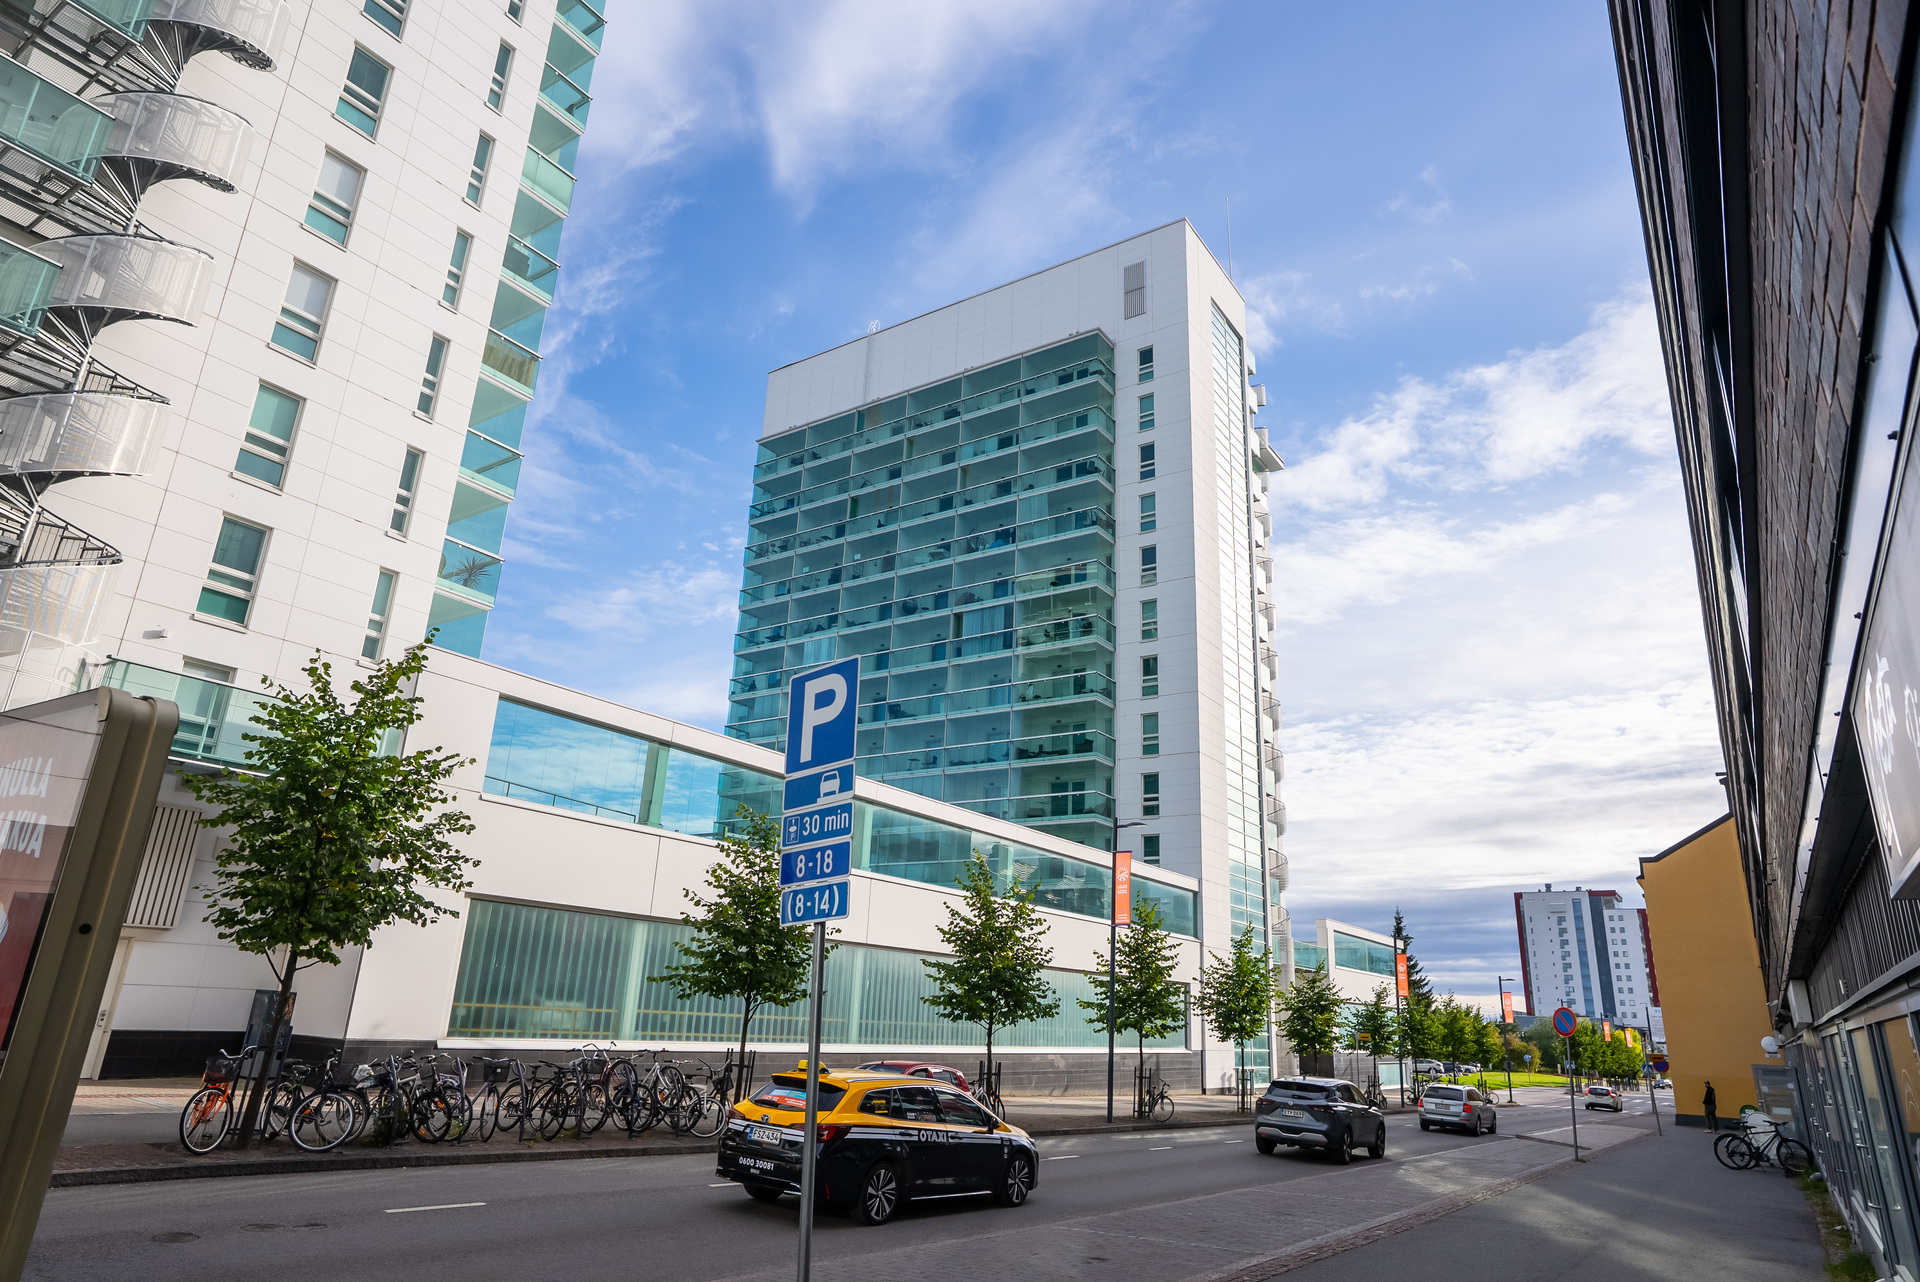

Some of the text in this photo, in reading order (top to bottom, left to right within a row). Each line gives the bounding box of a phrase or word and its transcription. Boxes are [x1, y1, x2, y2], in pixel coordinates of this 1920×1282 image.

[800, 673, 848, 764] P
[0, 756, 53, 798] NULLA
[0, 810, 47, 859] AKUA
[802, 809, 849, 836] 30 min
[796, 849, 833, 878] 8-18
[787, 885, 840, 922] (8-14)
[919, 1129, 947, 1142] OTAXI
[738, 1156, 774, 1170] 0600 30081
